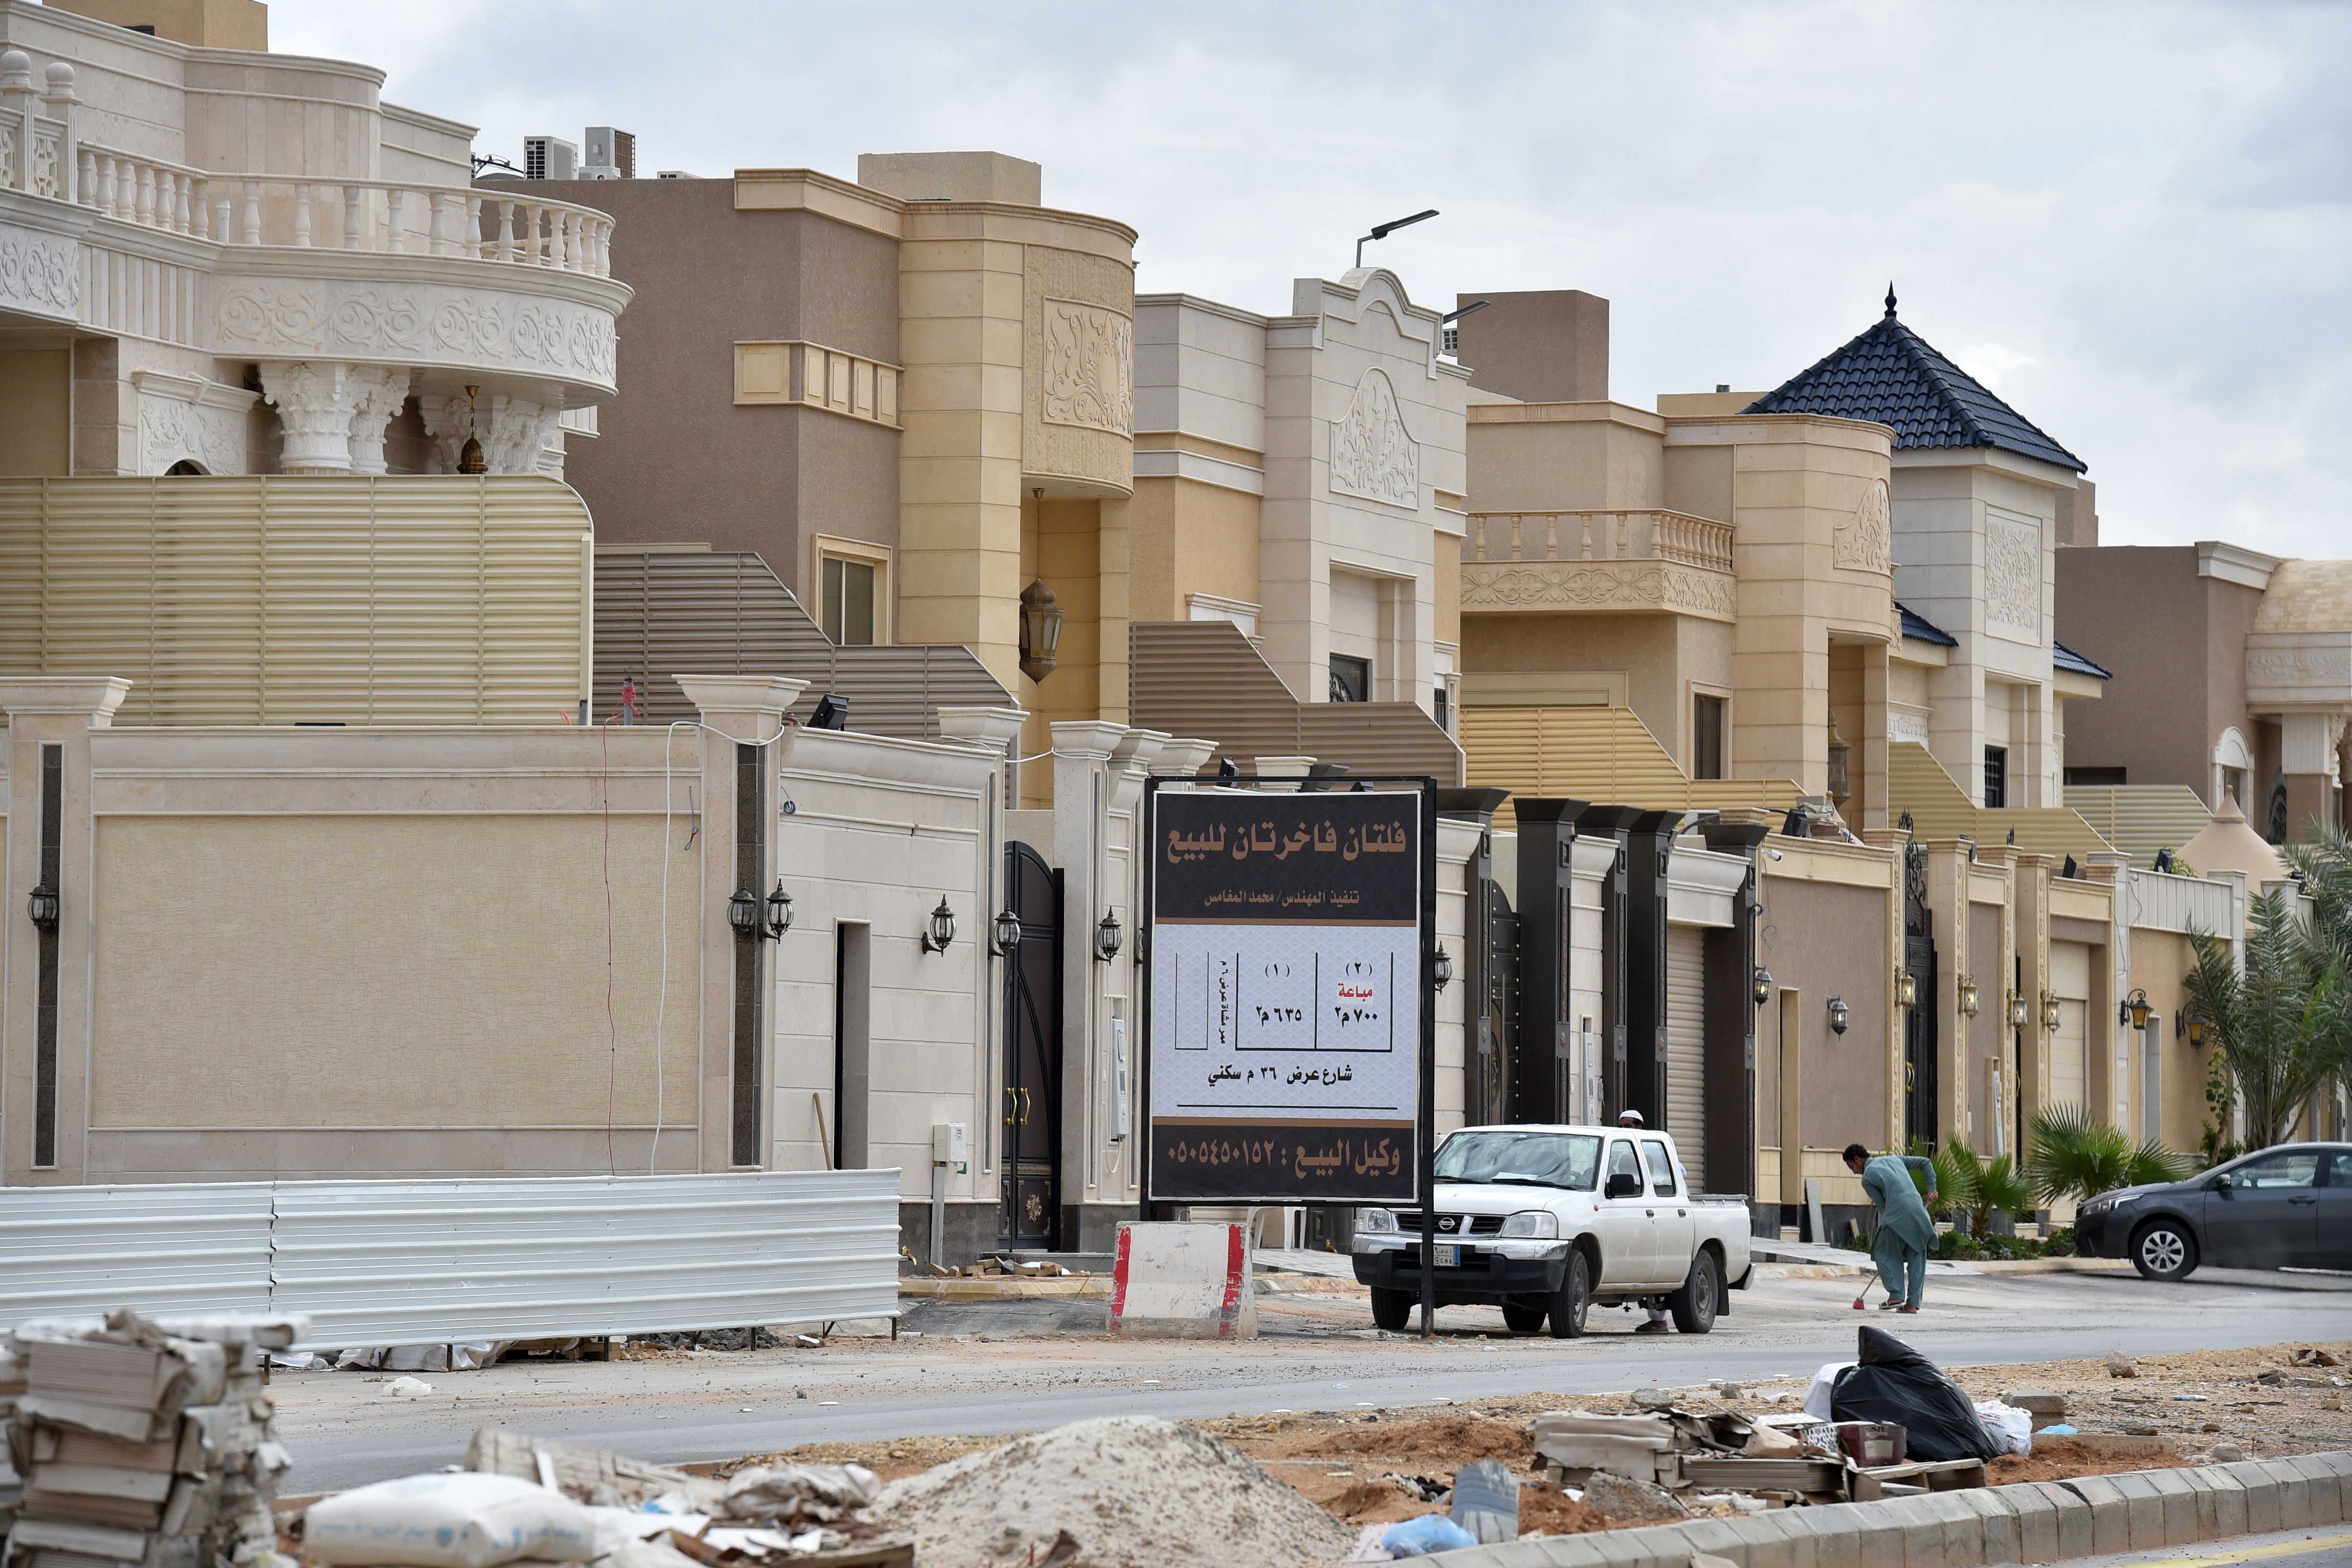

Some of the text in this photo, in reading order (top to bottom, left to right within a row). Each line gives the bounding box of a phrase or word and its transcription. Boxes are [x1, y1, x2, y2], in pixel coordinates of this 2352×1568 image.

[1167, 820, 1406, 864] فلتان فاخرتان للبيع
[1249, 891, 1274, 903] محمد
[1330, 890, 1360, 908] تنفيذ
[1219, 977, 1229, 1002] عرض
[1338, 982, 1373, 1001] مباعة
[1273, 1008, 1302, 1022] ٦٣٥
[1354, 1008, 1377, 1023] ٧٠٠
[1208, 1064, 1352, 1087] شارع عرض ٣٦ م سكني
[1168, 1139, 1275, 1166] ٠٥٠٥٤٥٠١٥٢
[1294, 1138, 1351, 1179] البيع
[1355, 1138, 1400, 1177] وكيل
